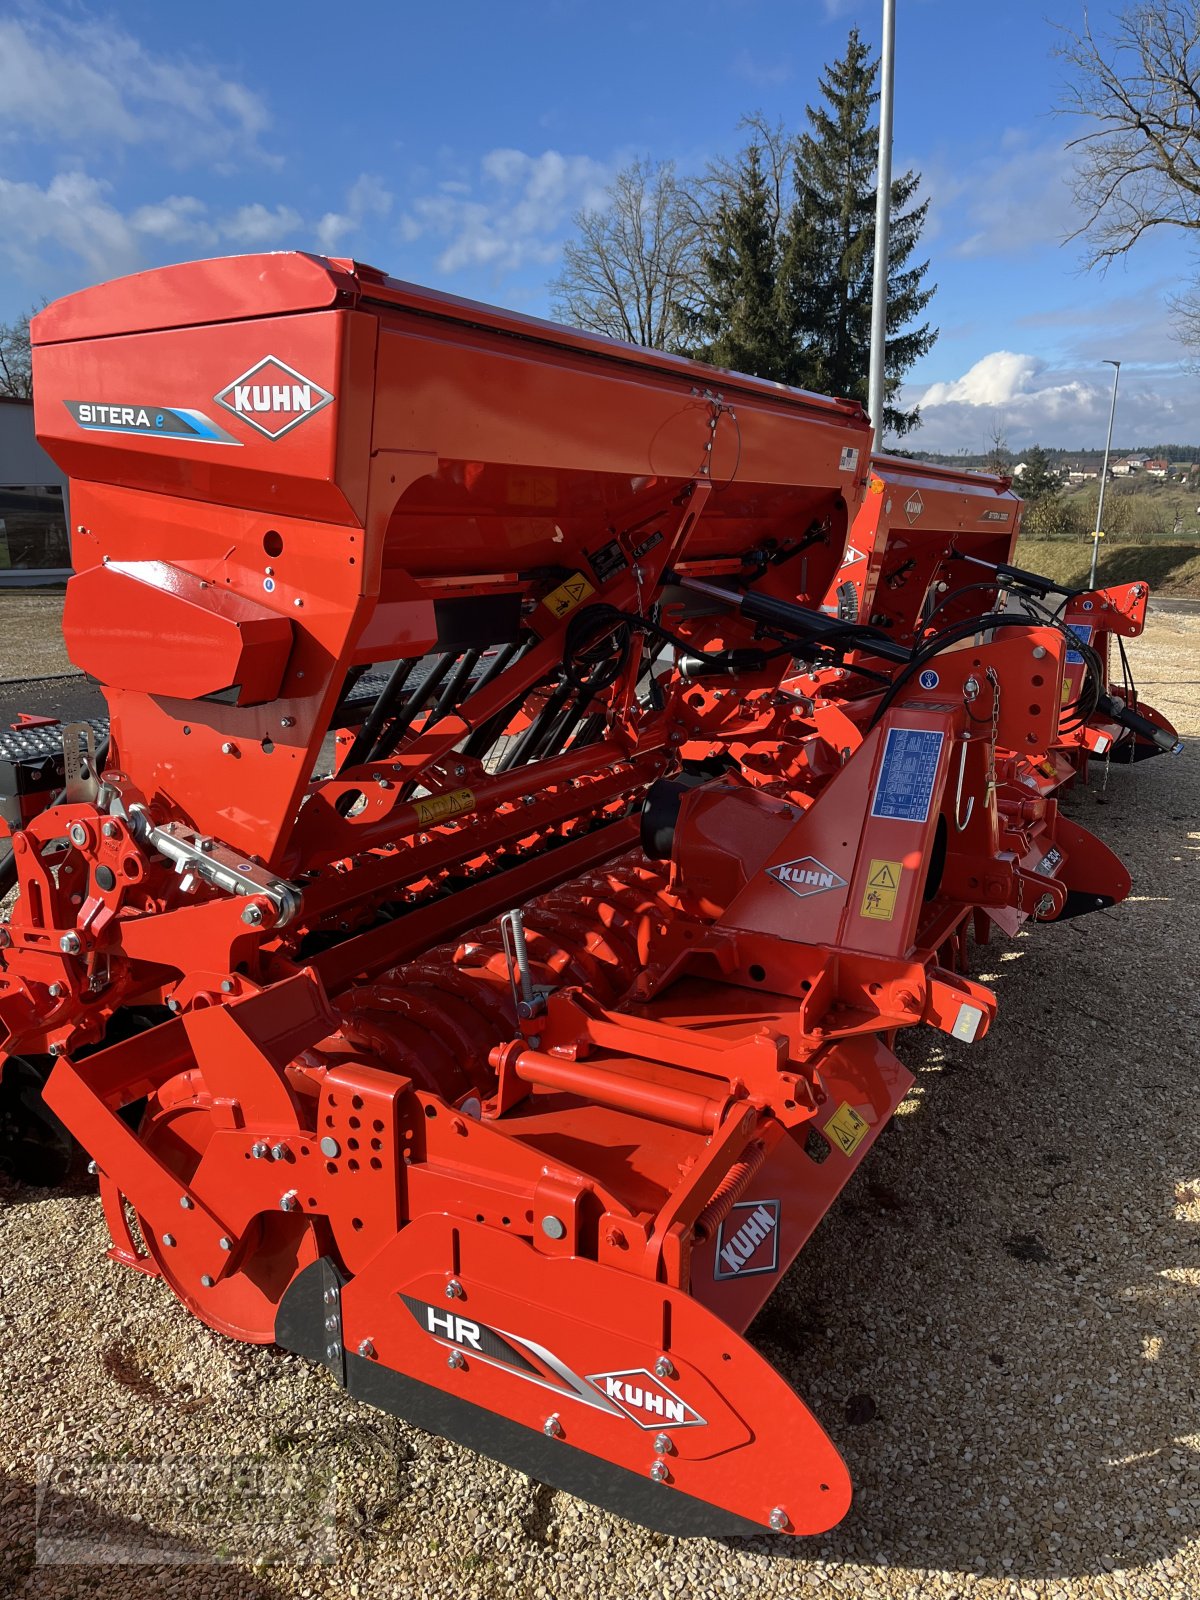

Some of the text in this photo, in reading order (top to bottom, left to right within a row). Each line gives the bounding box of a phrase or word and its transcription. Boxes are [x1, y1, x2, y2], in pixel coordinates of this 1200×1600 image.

[79, 404, 151, 427] SITERA
[234, 385, 311, 412] KUHN
[778, 866, 834, 888] KUHN
[720, 1204, 776, 1273] KUHN
[427, 1307, 483, 1351] HR
[606, 1376, 685, 1423] KUHN
